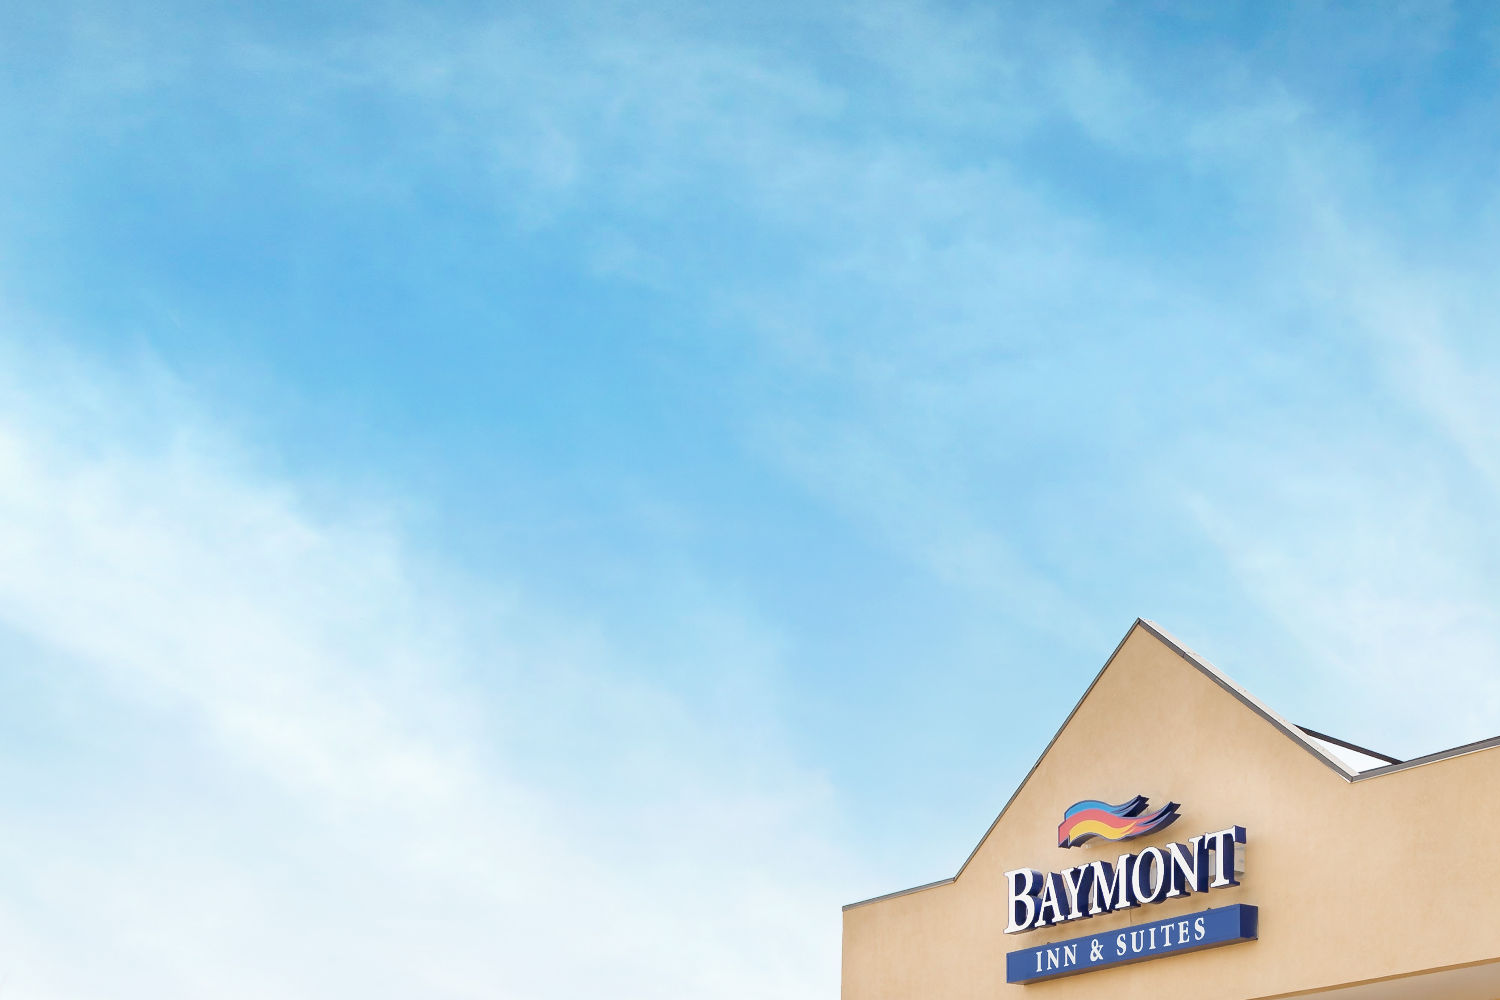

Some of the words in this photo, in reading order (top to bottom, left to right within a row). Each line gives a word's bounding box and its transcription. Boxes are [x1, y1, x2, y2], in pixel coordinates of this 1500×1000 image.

[1003, 825, 1246, 935] BAYMONT
[1036, 944, 1077, 972] INN
[1090, 938, 1103, 962] &
[1116, 917, 1206, 956] SUITES
